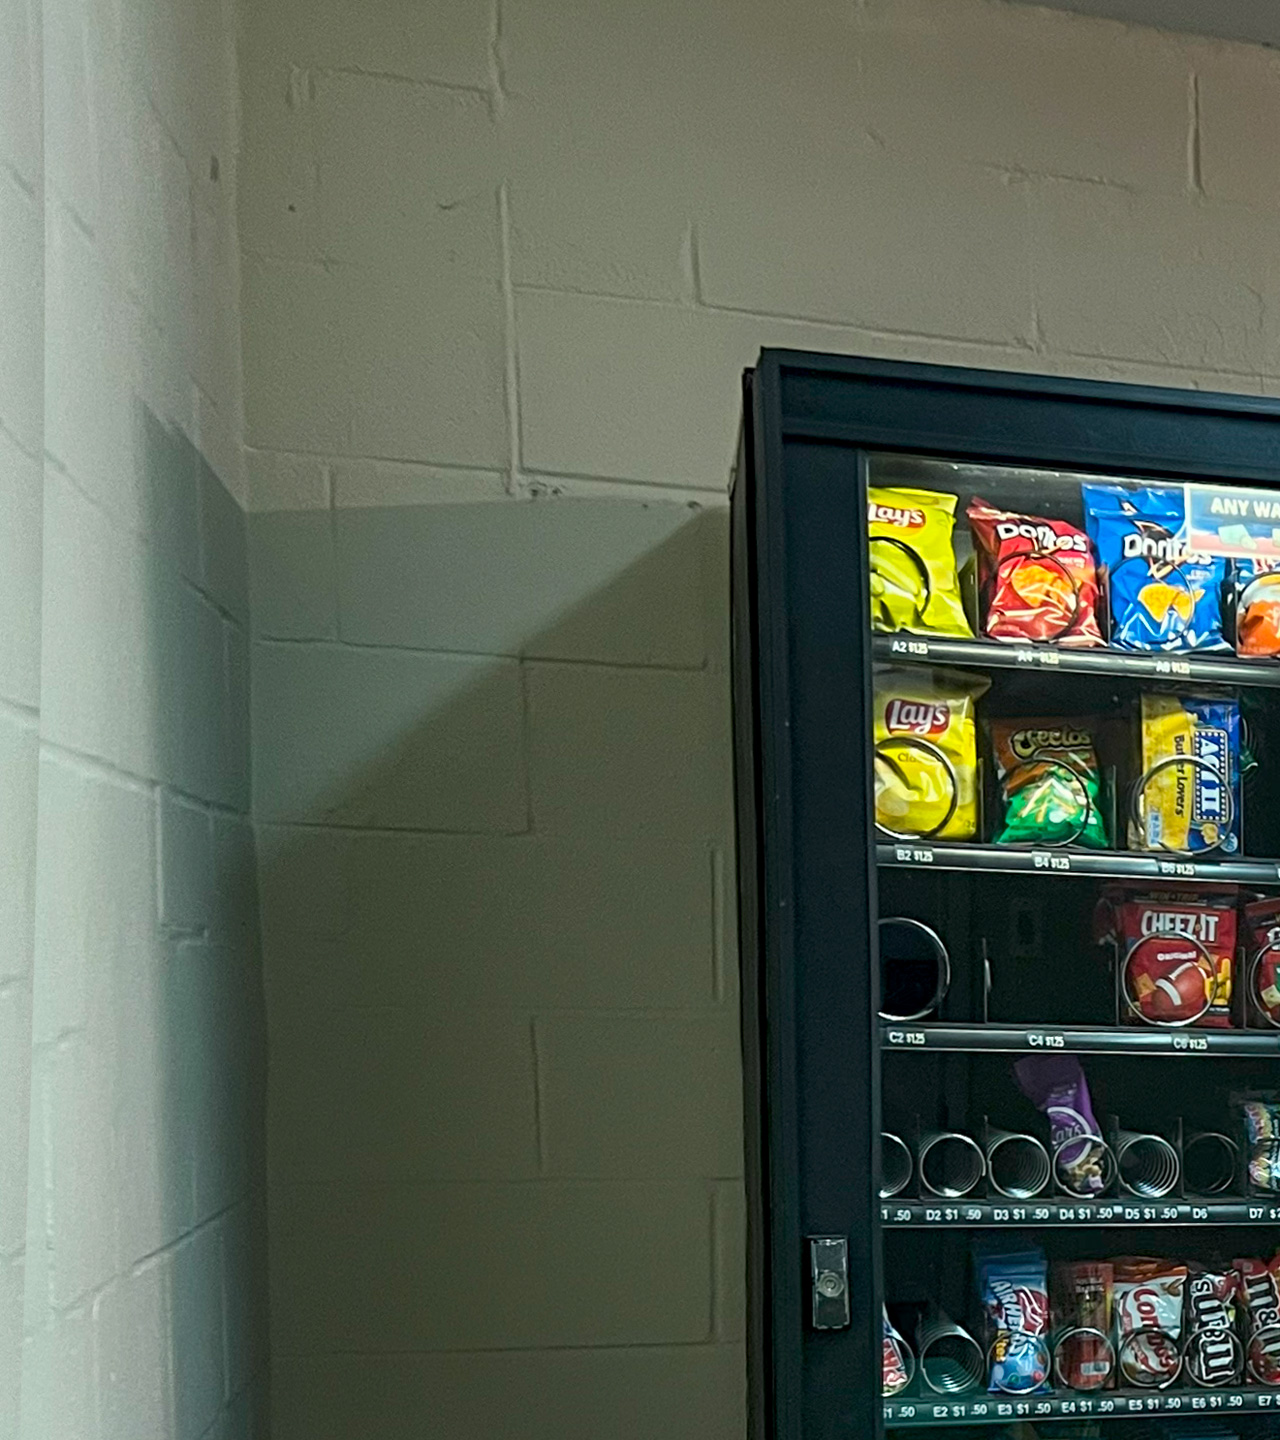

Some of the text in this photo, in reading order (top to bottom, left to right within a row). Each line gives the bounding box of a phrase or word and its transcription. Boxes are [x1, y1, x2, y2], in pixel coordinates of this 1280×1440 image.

[1210, 497, 1248, 516] ANY
[892, 641, 907, 653] A2
[889, 700, 948, 735] Lay's
[1174, 776, 1188, 818] Lovers
[1200, 786, 1220, 813] II
[896, 850, 912, 861] B2
[1034, 856, 1049, 868] B4
[888, 1032, 904, 1044] C2
[1028, 1035, 1044, 1046] C4
[926, 1210, 942, 1220] D2
[994, 1210, 1010, 1220] D3
[1060, 1209, 1075, 1220] D4
[1124, 1208, 1140, 1219] D5
[1192, 1208, 1208, 1218] D6
[1248, 1208, 1264, 1219] D7
[1128, 1400, 1143, 1410] E5
[1192, 1398, 1206, 1408] E6
[1258, 1396, 1272, 1406] E7
[933, 1406, 948, 1417] E2
[998, 1404, 1012, 1415] E3
[1062, 1402, 1076, 1413] E4
